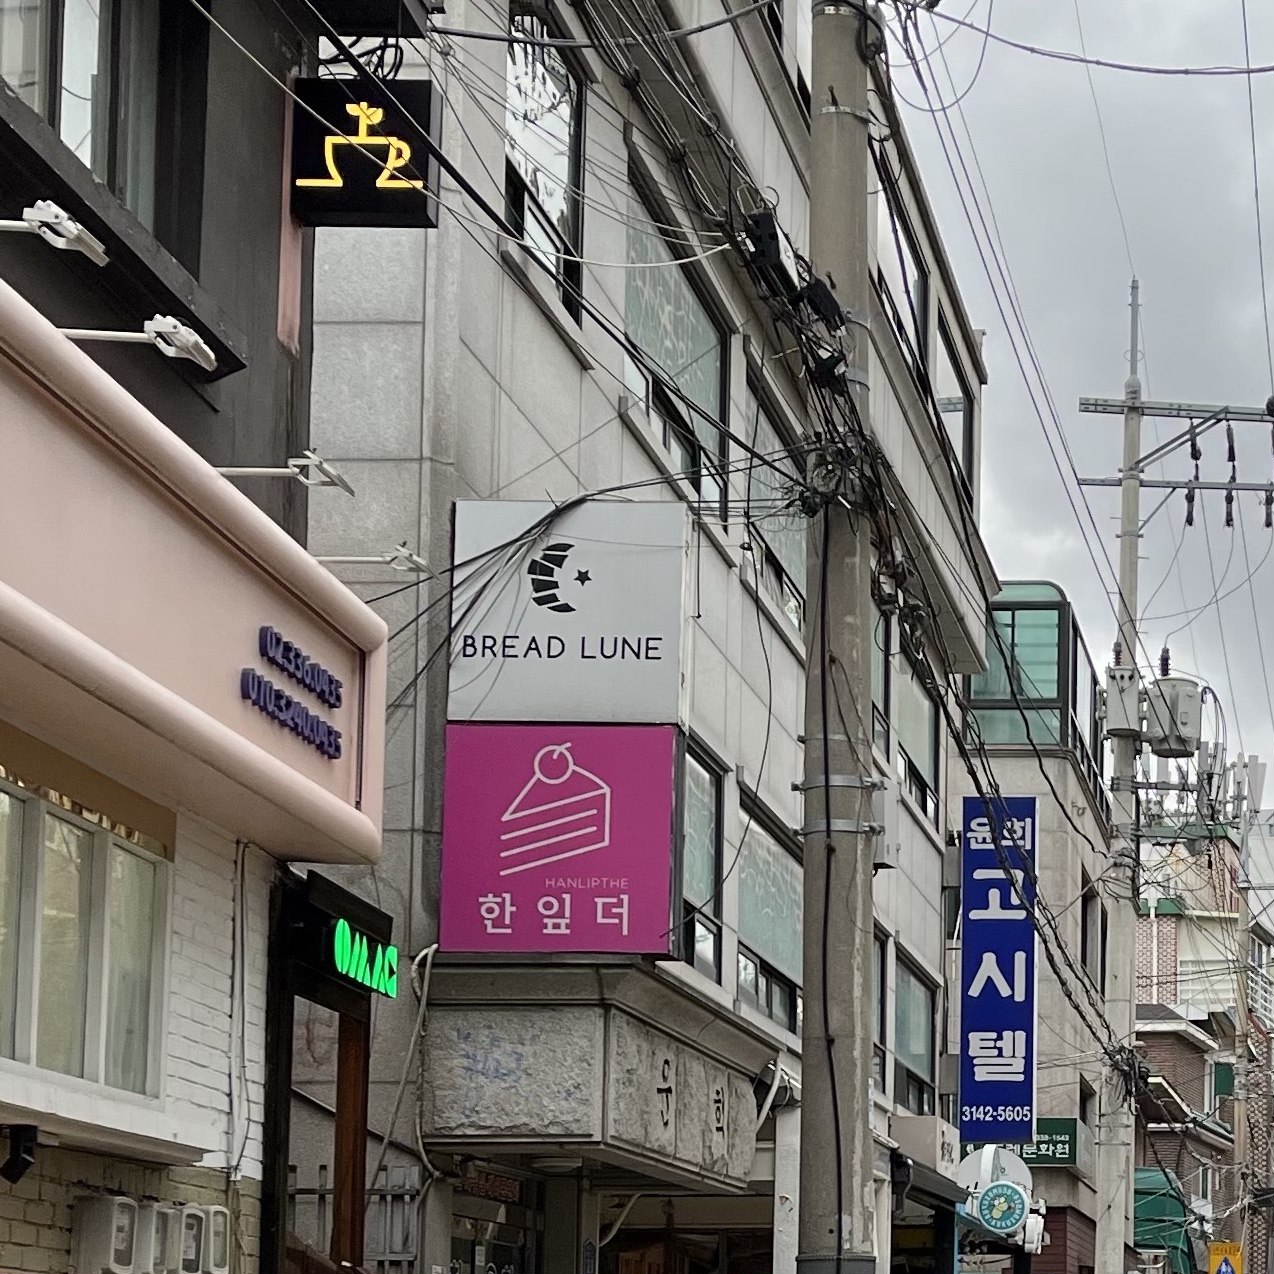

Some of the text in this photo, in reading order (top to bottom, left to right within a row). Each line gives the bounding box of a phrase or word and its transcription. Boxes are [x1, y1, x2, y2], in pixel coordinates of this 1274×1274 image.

[462, 635, 663, 660] BREAD LUNE
[545, 877, 629, 889] HANLIPTHE
[967, 868, 1028, 1082] 고시텔
[962, 1105, 1031, 1122] 3142-5605
